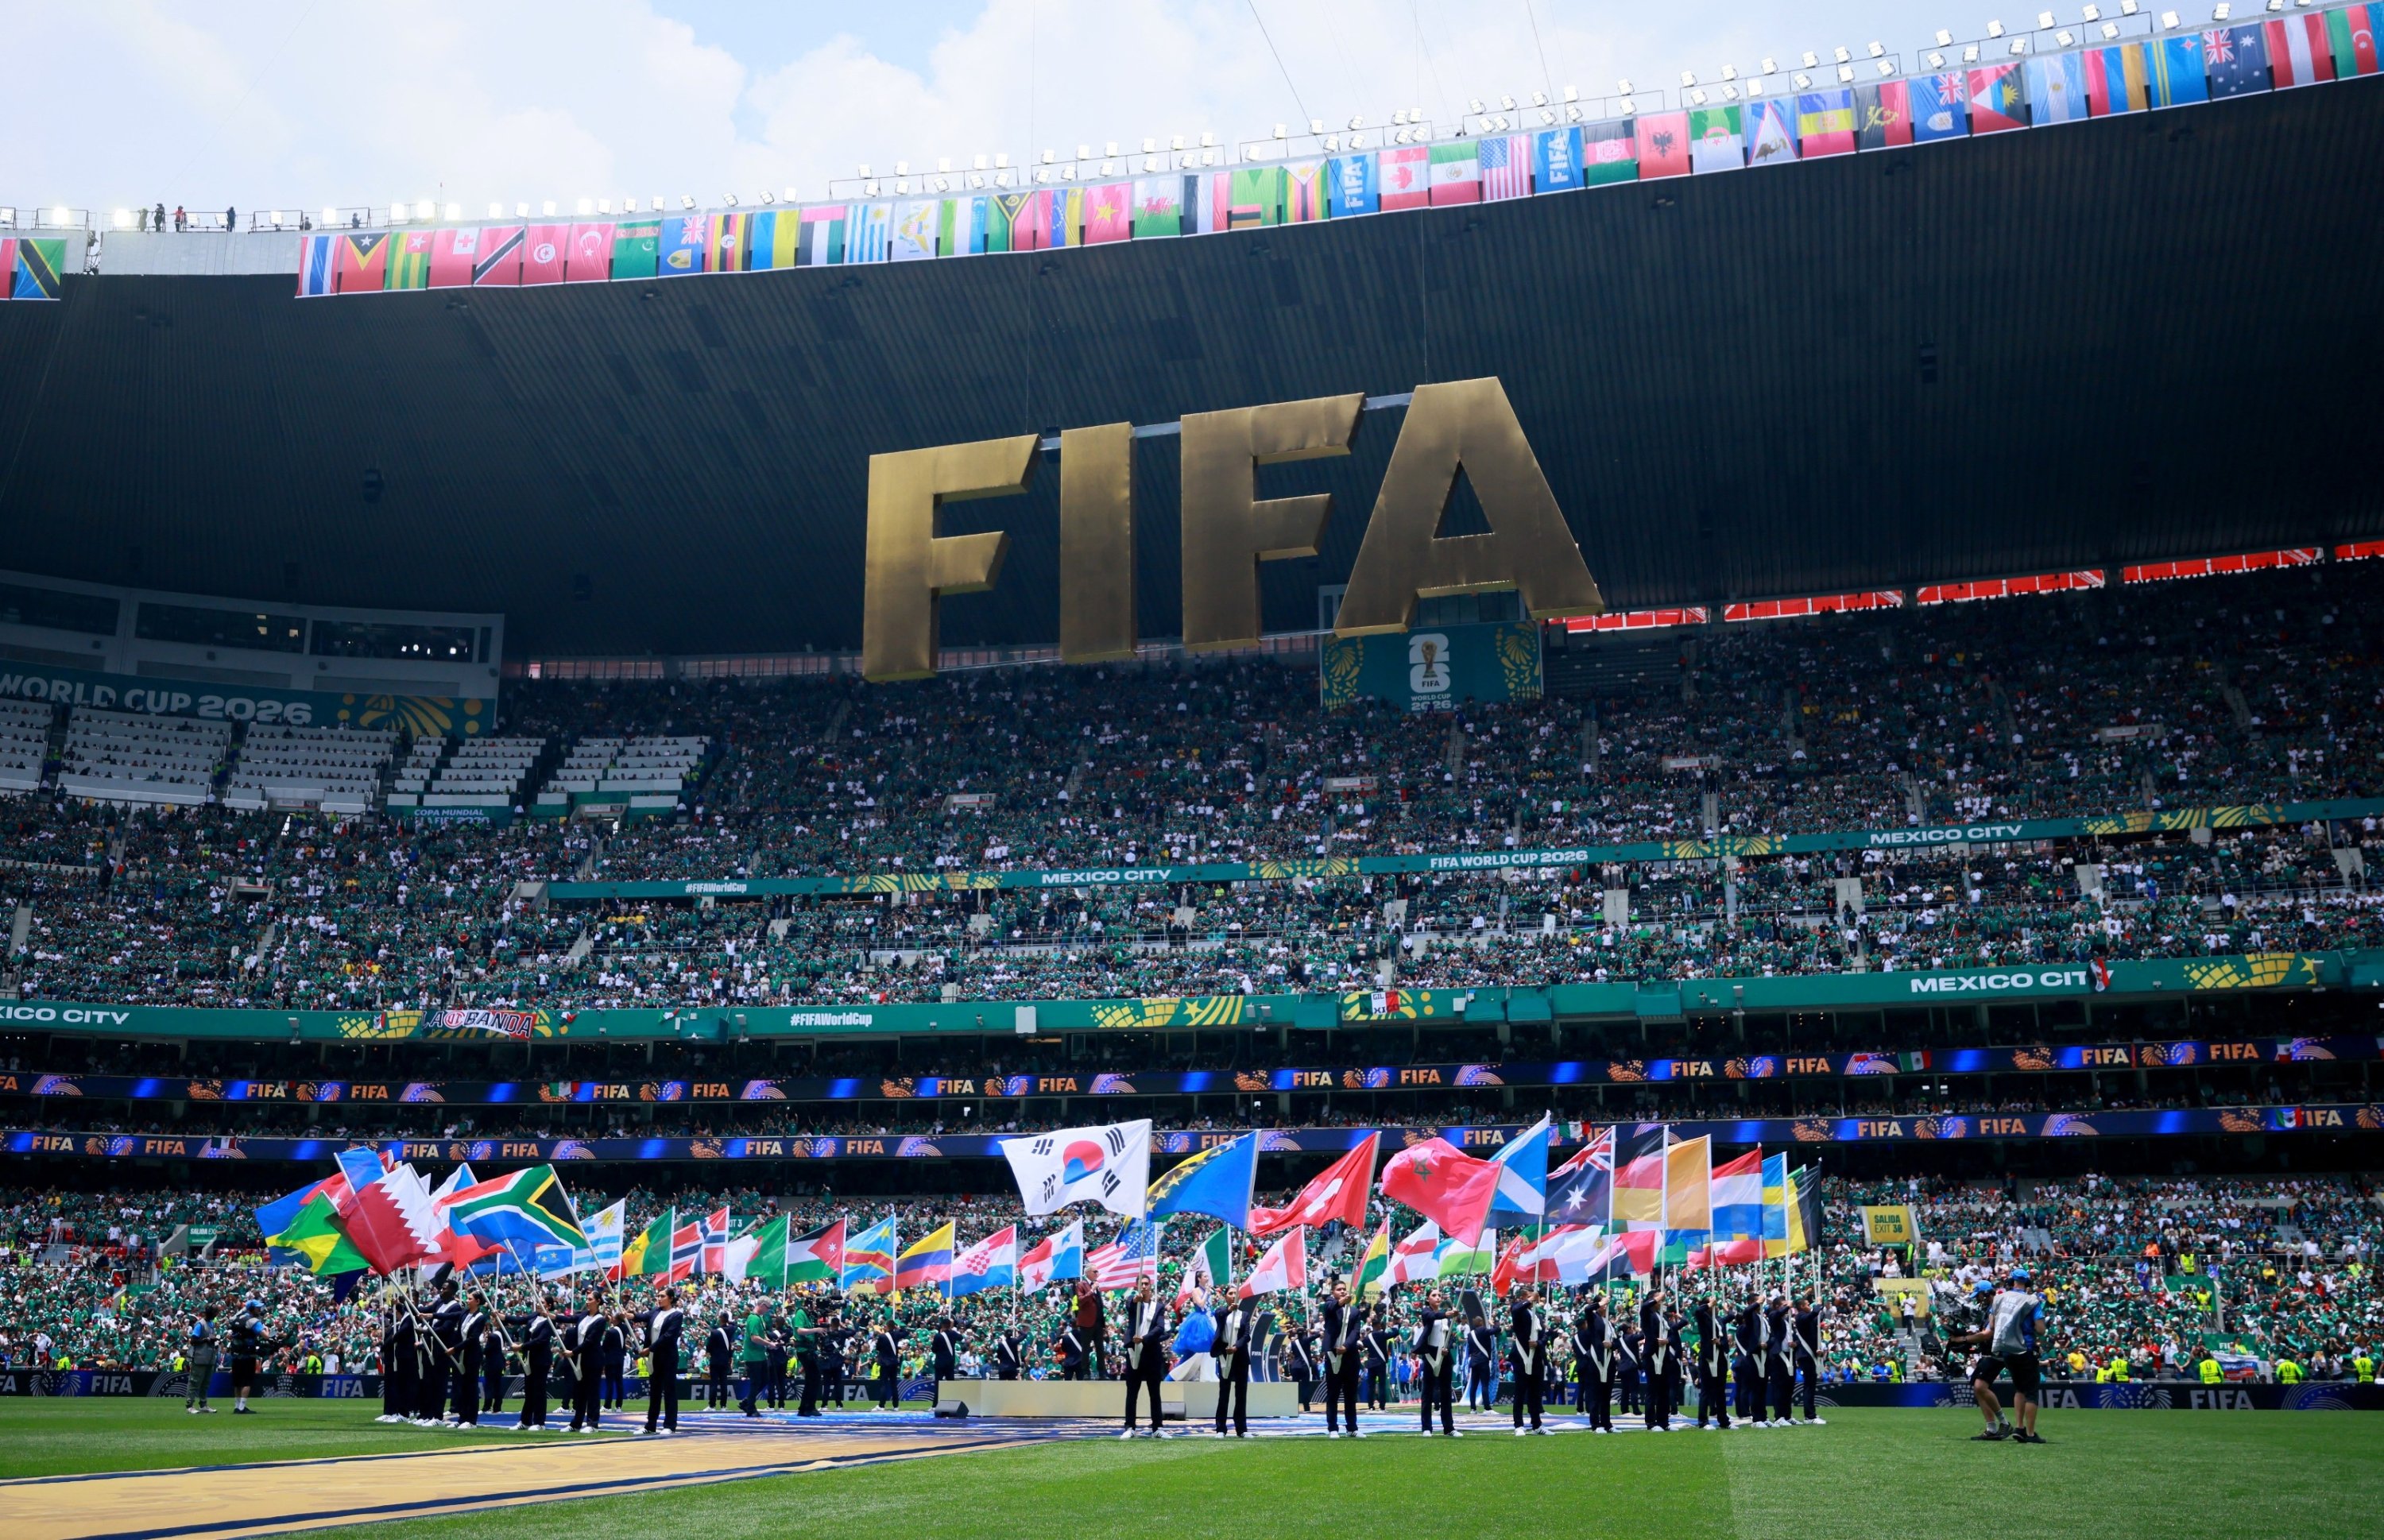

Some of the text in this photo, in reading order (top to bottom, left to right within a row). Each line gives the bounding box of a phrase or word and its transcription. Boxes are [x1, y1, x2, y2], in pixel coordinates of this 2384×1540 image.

[1547, 134, 1569, 184] FIFA
[1344, 161, 1364, 209] FIFA
[863, 376, 1604, 682] FIFA
[124, 688, 192, 713] CUP
[198, 695, 312, 725] 2026
[1871, 825, 2022, 844] MEXICO CITY
[1430, 849, 1589, 868] FIFA WORLD CUP 2026
[1042, 869, 1171, 884] MEXICO CITY
[685, 882, 747, 893] #FIFAWorldCup
[1910, 973, 2034, 992] MEXICO
[63, 1009, 130, 1024] CITY
[463, 1010, 533, 1038] BANDA
[790, 1012, 873, 1027] #FIFAWorldCup
[2081, 1048, 2129, 1064] FIFA
[2210, 1043, 2259, 1060] FIFA
[1670, 1061, 1713, 1076] FIFA
[1786, 1058, 1830, 1073] FIFA
[1293, 1071, 1333, 1086] FIFA
[1401, 1070, 1441, 1084] FIFA
[247, 1084, 285, 1097] FIFA
[351, 1085, 389, 1098] FIFA
[593, 1085, 630, 1098] FIFA
[692, 1083, 730, 1097] FIFA
[937, 1079, 974, 1093] FIFA
[1039, 1078, 1078, 1092] FIFA
[2302, 1110, 2343, 1126] IFA
[1858, 1122, 1902, 1136] FIFA
[1980, 1118, 2026, 1134] FIFA
[32, 1136, 74, 1151] FIFA
[1464, 1130, 1505, 1144] FIFA
[145, 1140, 185, 1154] FIFA
[402, 1144, 439, 1158] FIFA
[502, 1143, 539, 1157] FIFA
[745, 1141, 783, 1155] FIFA
[846, 1140, 884, 1154] FIFA
[91, 1376, 133, 1393] FIFA
[321, 1379, 364, 1398] FIFA
[2038, 1389, 2080, 1409] IFA
[2189, 1389, 2254, 1410] FIFA
